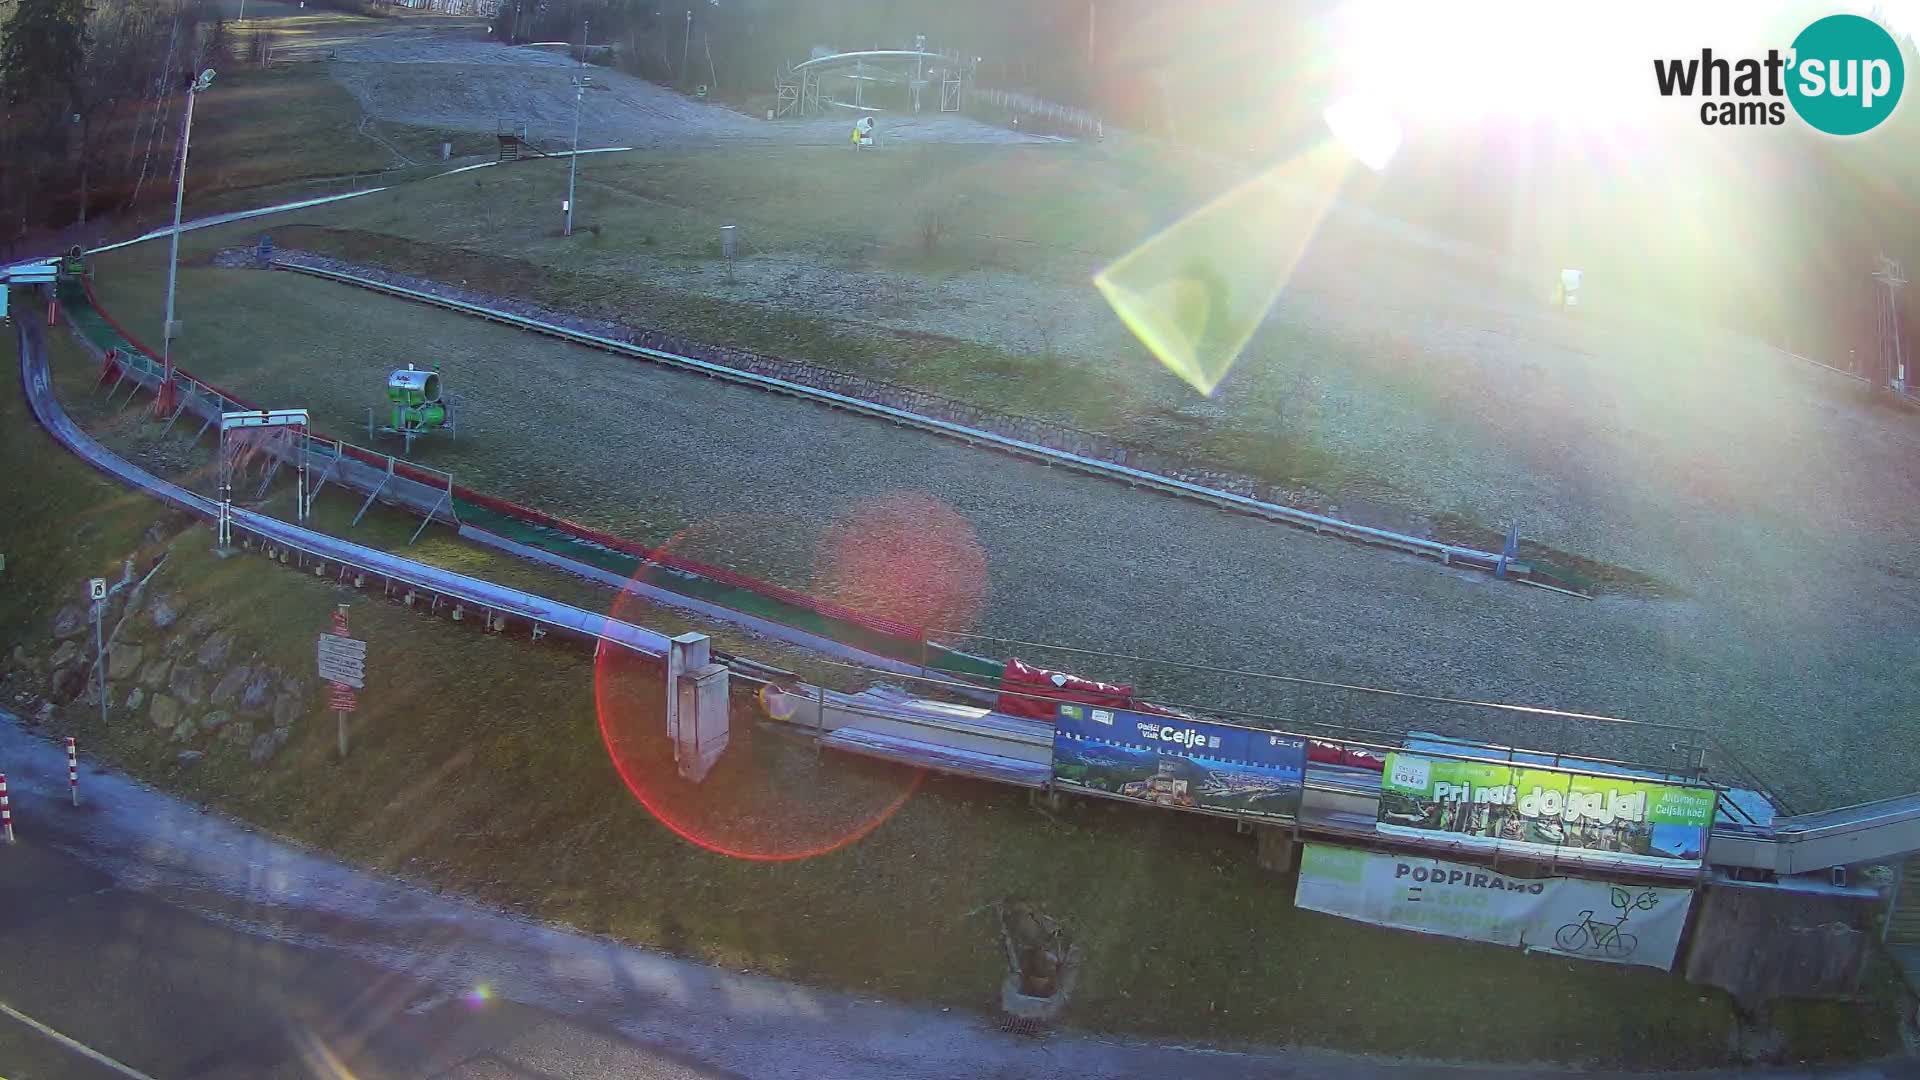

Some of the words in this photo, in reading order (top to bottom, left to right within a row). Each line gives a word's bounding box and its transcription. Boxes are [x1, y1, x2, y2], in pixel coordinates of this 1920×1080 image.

[1161, 726, 1206, 749] Celje
[1433, 781, 1470, 803] Pri
[1395, 863, 1545, 895] PODPIRAMO
